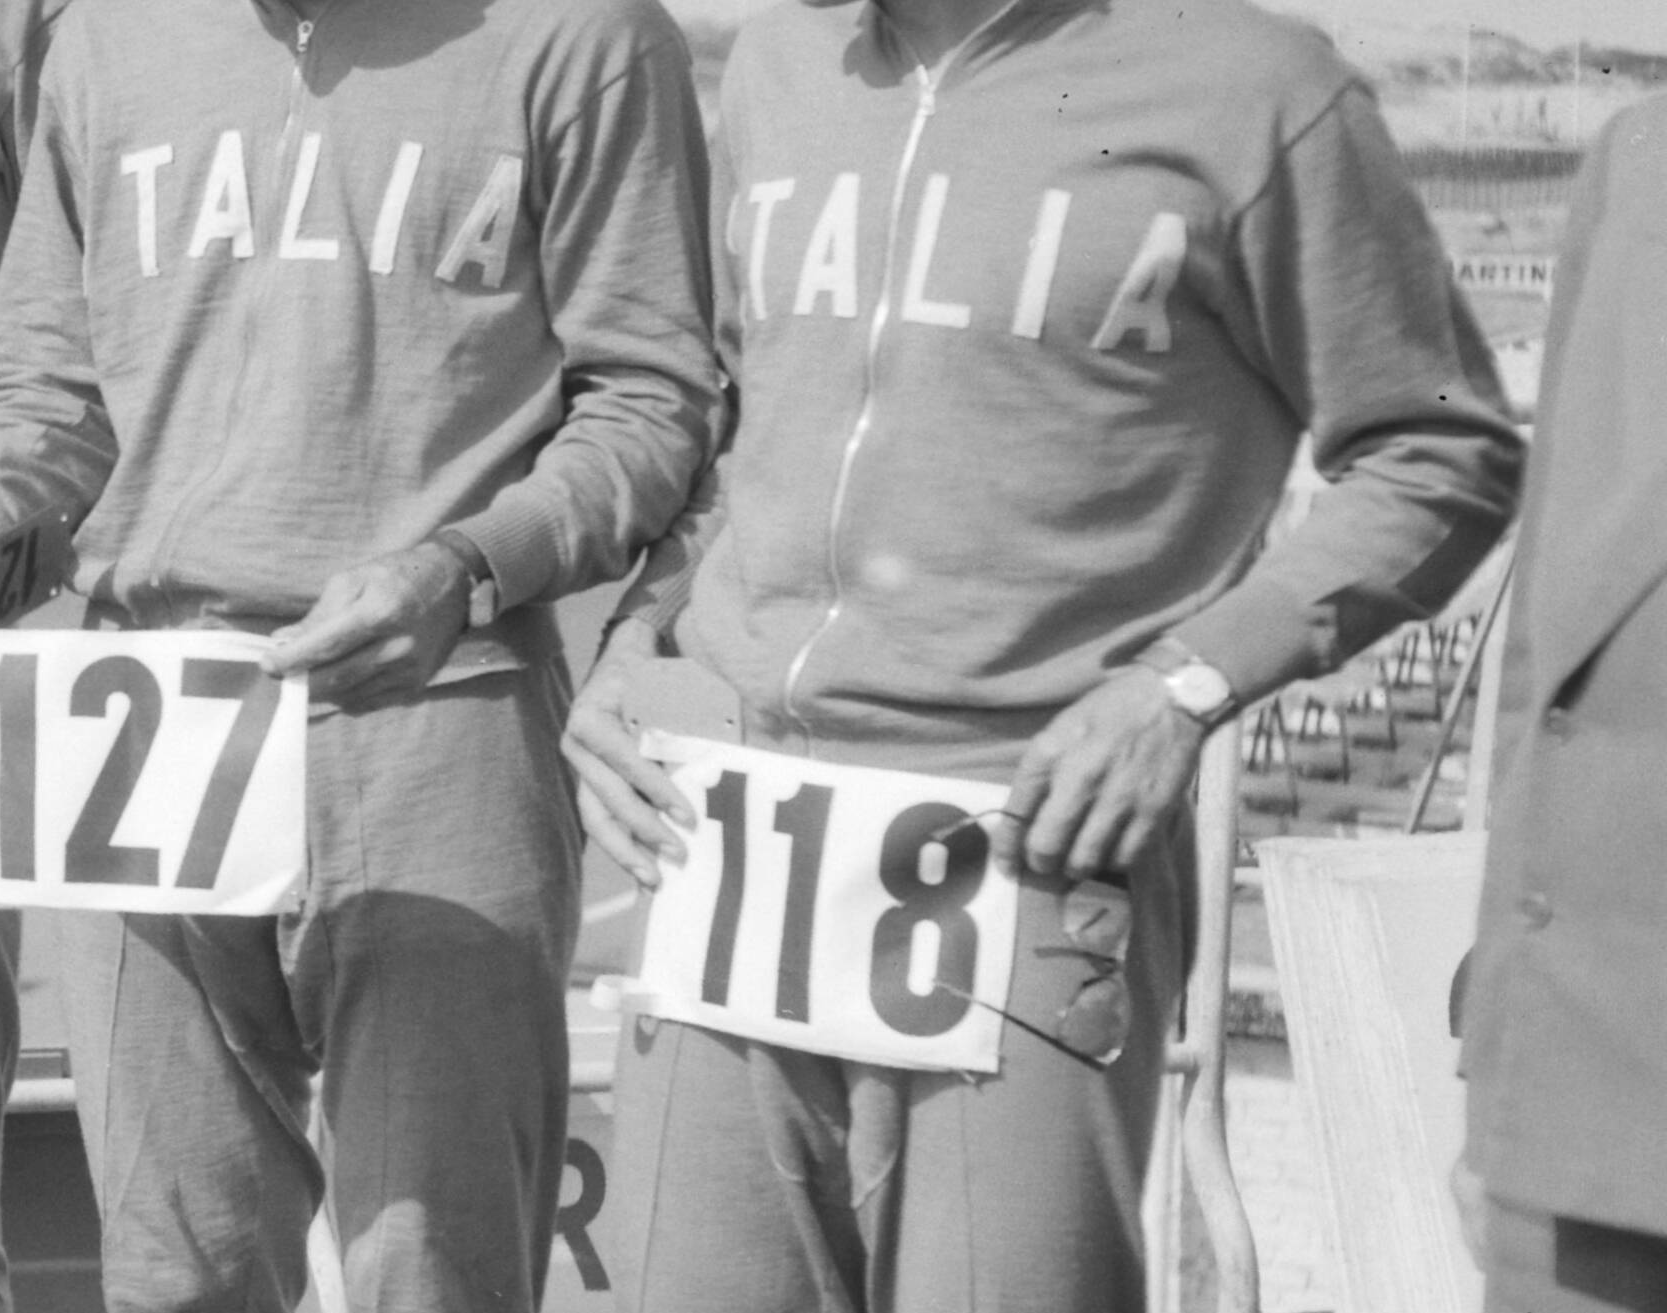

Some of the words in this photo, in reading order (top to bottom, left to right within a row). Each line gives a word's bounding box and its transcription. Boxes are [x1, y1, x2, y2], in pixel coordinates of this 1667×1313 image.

[120, 131, 524, 287] TALIA
[727, 171, 1187, 352] TALIA
[1456, 262, 1548, 285] ARTIN
[700, 767, 991, 1038] 118
